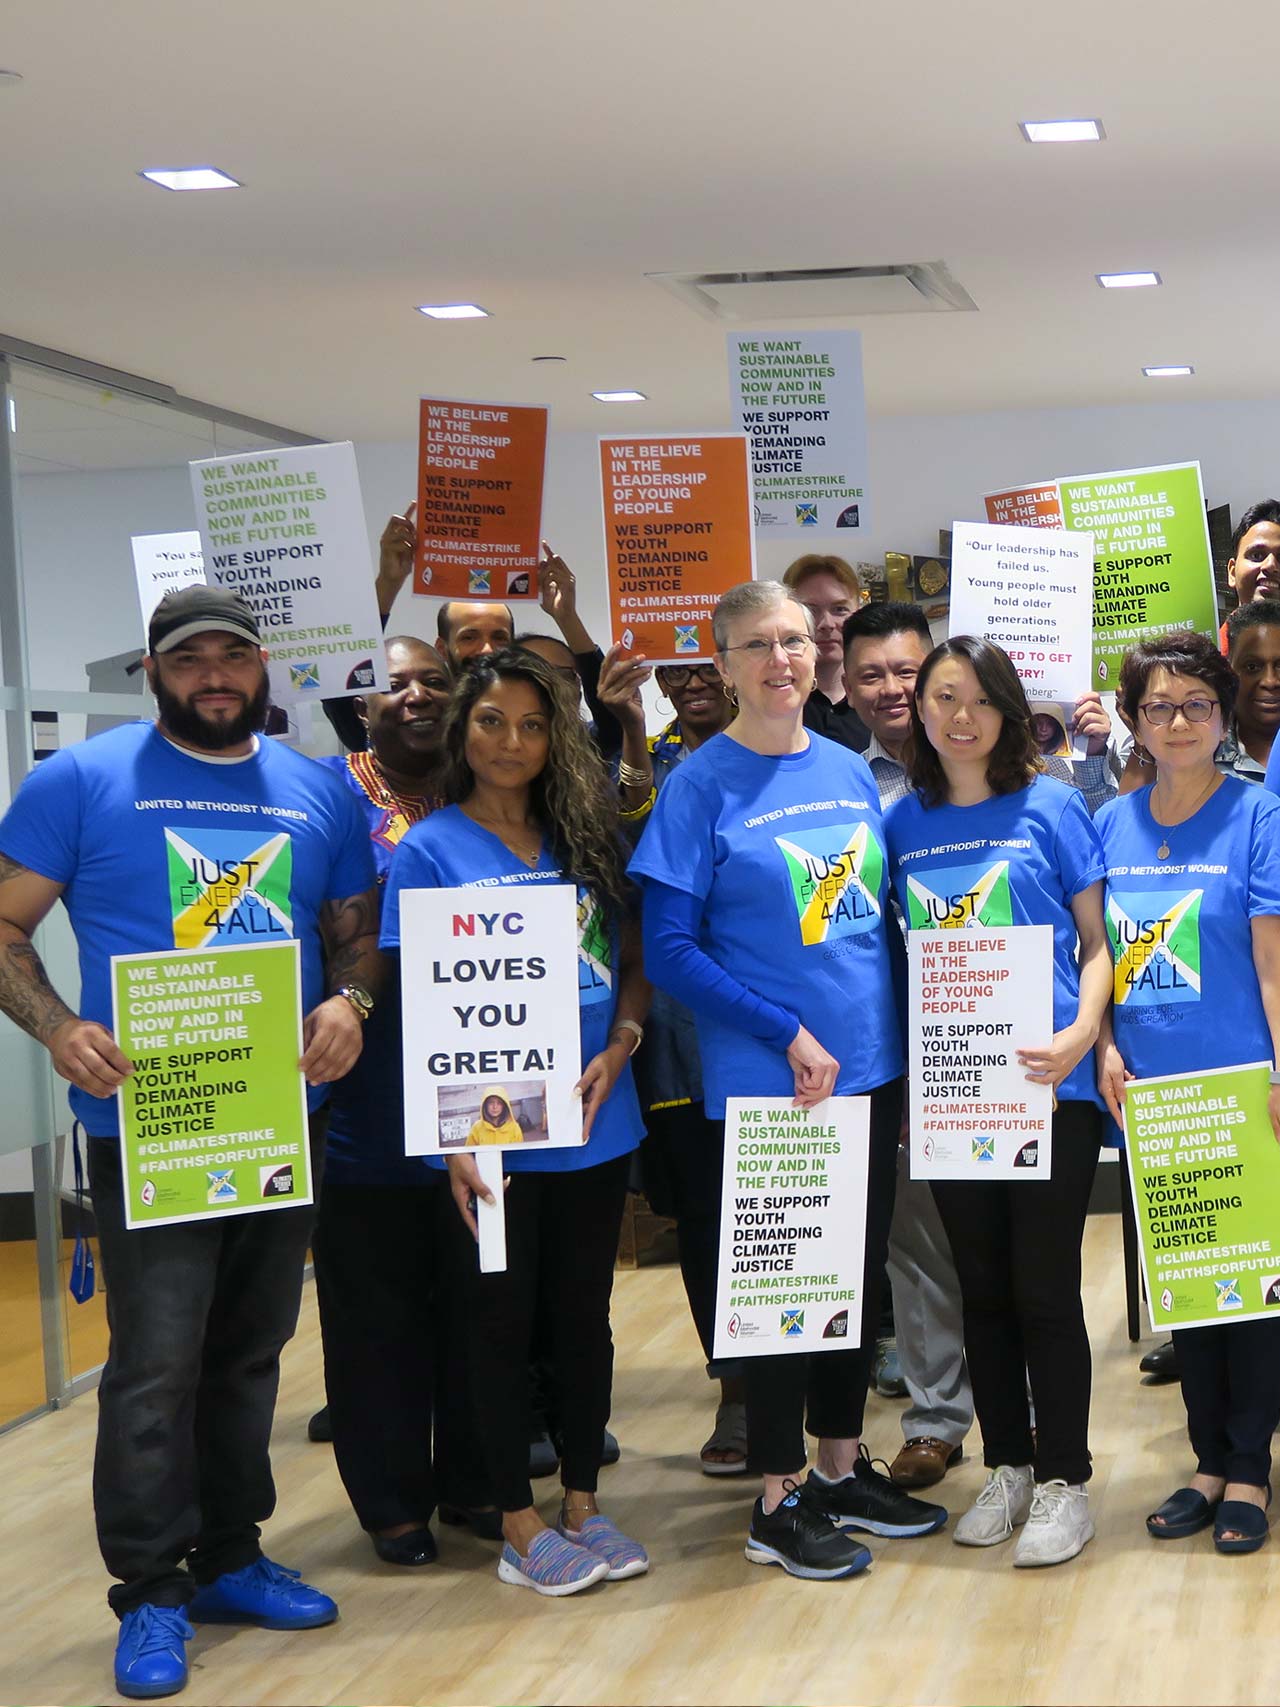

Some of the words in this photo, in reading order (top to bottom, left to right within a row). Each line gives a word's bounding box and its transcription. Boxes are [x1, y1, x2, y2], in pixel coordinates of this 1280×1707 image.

[737, 341, 760, 354] WE
[762, 340, 803, 353] WANT
[738, 353, 831, 367] SUSTAINABLE
[426, 416, 443, 431] IN
[443, 418, 472, 434] THE
[426, 429, 512, 448] LEADERSHIP
[609, 444, 636, 459] WE
[637, 443, 703, 459] BELIEVE
[994, 498, 1013, 510] WE
[1017, 491, 1058, 504] BELIEV
[1070, 490, 1169, 516] SUSTAINABLE
[996, 512, 1008, 521] IN
[1012, 506, 1036, 517] THE
[1072, 504, 1176, 529] COMMUNITIES
[207, 530, 244, 549] THE
[246, 522, 317, 544] FUTURE
[211, 552, 240, 569] WE
[242, 543, 324, 565] SUPPORT
[423, 552, 537, 567] #FAITHSFORFUTURE
[996, 543, 1056, 558] leadership
[1060, 547, 1079, 558] has
[617, 564, 684, 580] CLIMATE
[998, 560, 1029, 571] failed
[1033, 563, 1049, 573] us.
[968, 577, 1004, 591] Young
[1007, 581, 1046, 594] people
[1050, 583, 1076, 594] must
[994, 597, 1019, 606] hold
[1023, 599, 1051, 609] older
[988, 614, 1056, 627] generations
[984, 632, 1060, 644] accountable!
[1006, 651, 1025, 660] ED
[1029, 652, 1045, 661] TO
[1049, 654, 1072, 663] GET
[1016, 669, 1044, 678] GRY!
[135, 800, 183, 811] UNITED
[186, 801, 258, 814] METHODIST
[261, 806, 308, 821] WOMEN
[744, 810, 784, 829] UNITED
[785, 801, 838, 816] METHODIST
[839, 800, 870, 810] WOMEN
[898, 849, 928, 866] UNITED
[930, 840, 986, 855] METHODIST
[989, 839, 1031, 848] WOMEN
[188, 858, 258, 887] JUST
[805, 850, 856, 883] JUST
[1130, 865, 1185, 875] METHODIST
[1188, 864, 1228, 875] WOMEN
[501, 870, 563, 884] METHODIS
[180, 886, 269, 907] ENERGY
[800, 874, 868, 905] ENERGY
[821, 896, 875, 925] 4ALL
[924, 892, 979, 923] JUST
[204, 908, 284, 934] 4ALL
[452, 912, 525, 937] NYC
[1116, 919, 1171, 945] JUST
[920, 940, 944, 955] WE
[947, 938, 1007, 954] BELIEVE
[126, 965, 159, 983] WE
[161, 959, 218, 979] WANT
[433, 956, 547, 984] LOVES
[921, 956, 936, 970] IN
[939, 955, 968, 969] THE
[921, 968, 1010, 985] LEADERSHIP
[1125, 964, 1188, 990] 4ALL
[127, 973, 256, 1000] SUSTAINABLE
[921, 986, 941, 1000] OF
[943, 984, 994, 999] YOUNG
[128, 989, 263, 1017] COMMUNITIES
[921, 1000, 977, 1015] PEOPLE
[128, 1015, 176, 1035] NOW
[179, 1010, 221, 1030] AND
[223, 1008, 245, 1024] IN
[453, 1003, 527, 1029] YOU
[129, 1033, 169, 1051] THE
[172, 1024, 249, 1047] FUTURE
[427, 1048, 555, 1076] GRETA!
[734, 1196, 759, 1211] WE
[762, 1194, 831, 1210] SUPPORT
[733, 1211, 786, 1227] YOUTH
[733, 1225, 823, 1243] DEMANDING
[732, 1242, 797, 1258] CLIMATE
[1154, 1239, 1272, 1266] #CLIMATESTRIKE
[730, 1258, 794, 1274] JUSTICE
